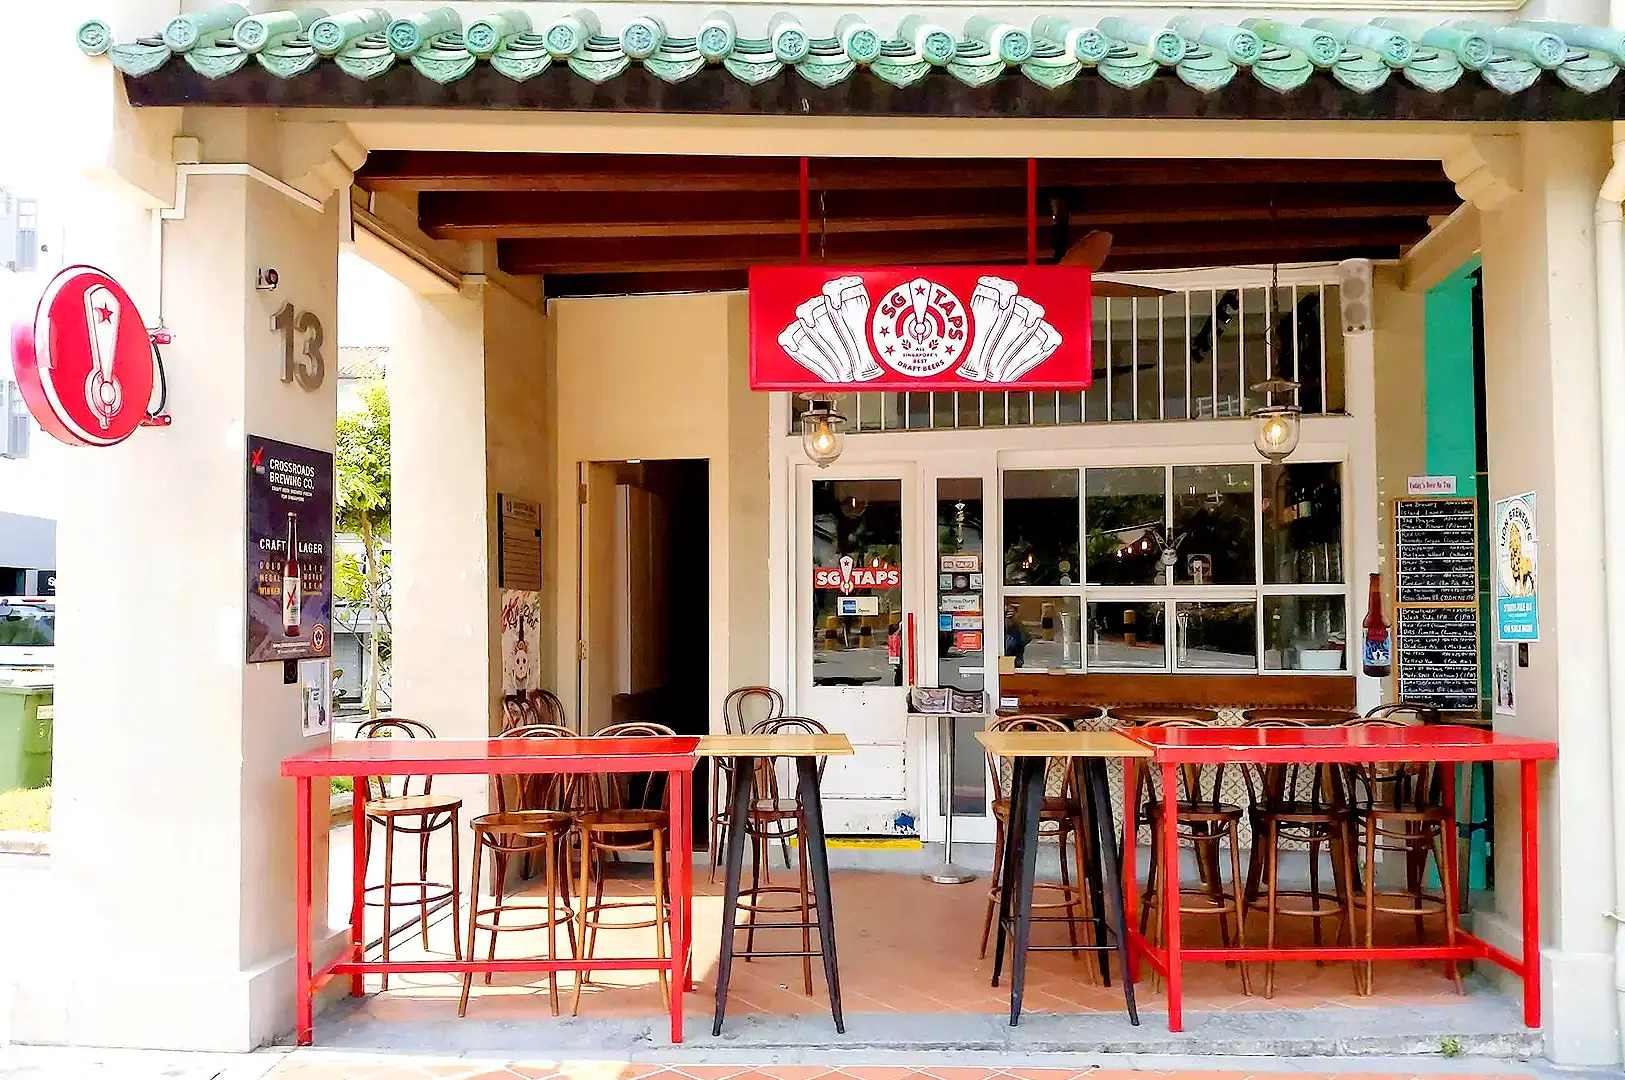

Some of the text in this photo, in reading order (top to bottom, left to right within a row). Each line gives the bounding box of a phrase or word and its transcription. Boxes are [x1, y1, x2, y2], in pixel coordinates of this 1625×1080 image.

[881, 288, 964, 341] SG TAPS
[270, 302, 325, 392] 13
[897, 359, 945, 372] DRAFT BEERS
[269, 458, 315, 477] CROSSROADS
[269, 471, 315, 490] BREWING CO.
[1501, 518, 1509, 547] LION
[1509, 507, 1531, 531] BREWERY
[259, 538, 323, 555] CRAFT LAGER
[816, 570, 899, 586] SG TAPS
